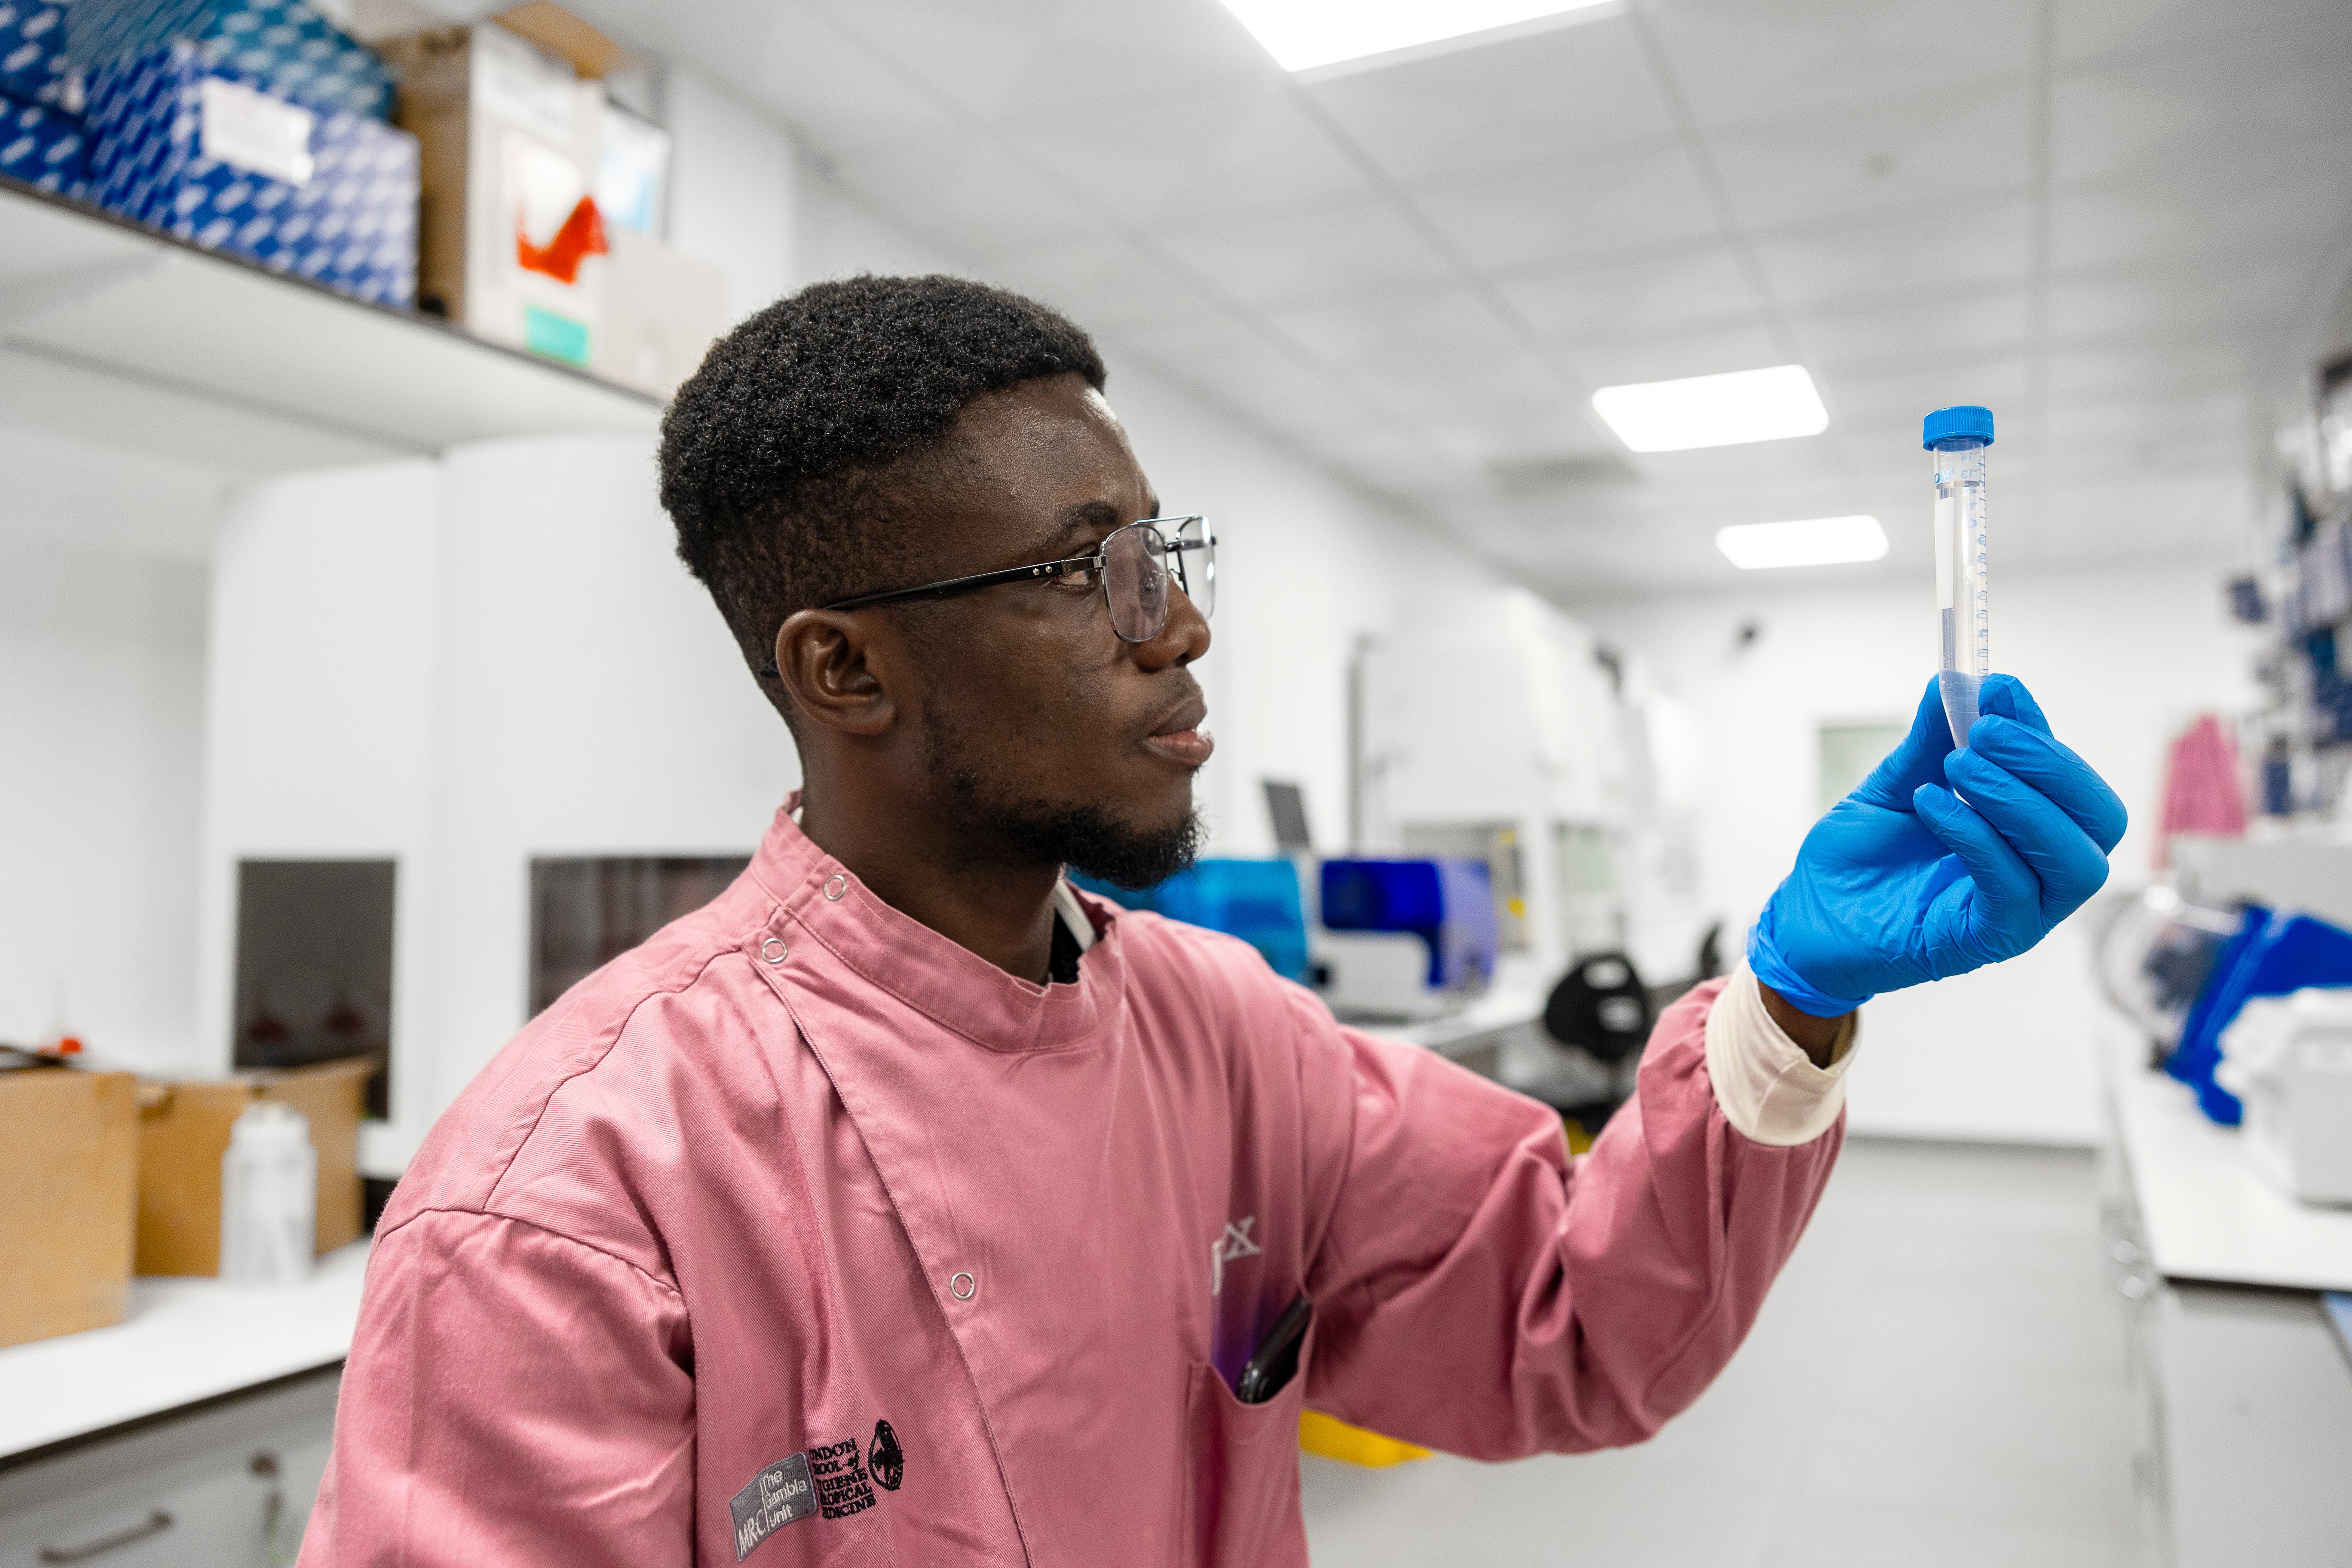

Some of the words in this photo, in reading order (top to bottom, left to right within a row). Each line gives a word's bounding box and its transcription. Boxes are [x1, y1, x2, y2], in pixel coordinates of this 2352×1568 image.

[809, 1438, 858, 1461] ONDON
[816, 1467, 868, 1492] GIENE
[822, 1494, 876, 1520] EDICINE
[738, 1508, 766, 1558] MRC
